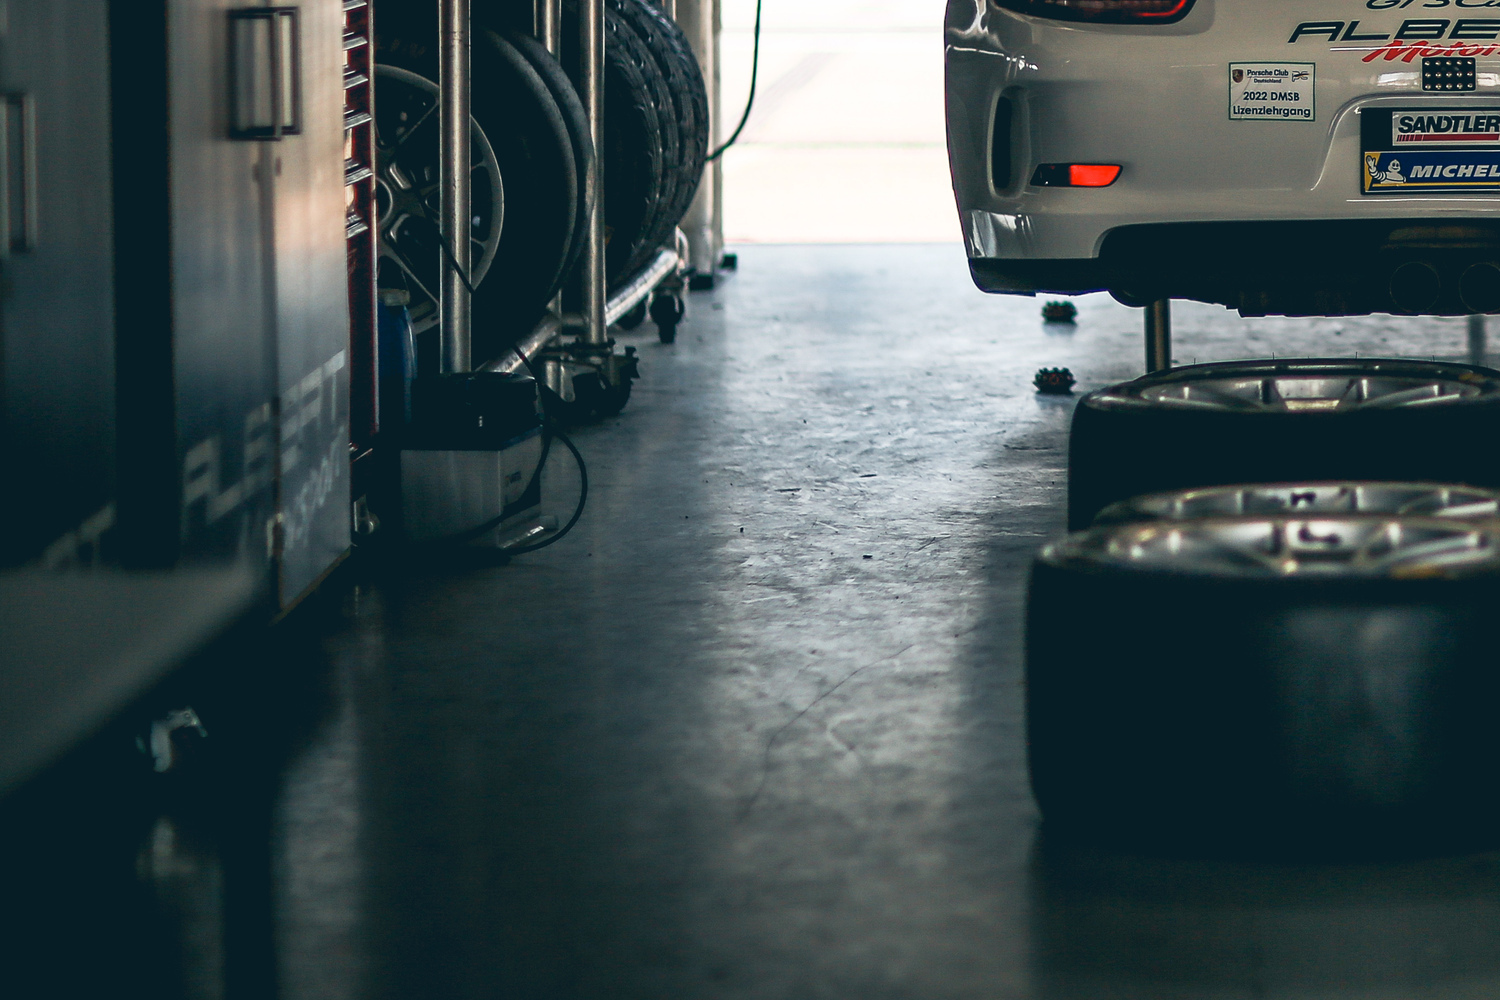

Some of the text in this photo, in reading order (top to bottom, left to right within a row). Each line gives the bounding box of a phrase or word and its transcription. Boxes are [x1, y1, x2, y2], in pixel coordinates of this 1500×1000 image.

[1243, 91, 1300, 101] 2022 DMSB
[1233, 105, 1311, 118] Lizenzlehrgang
